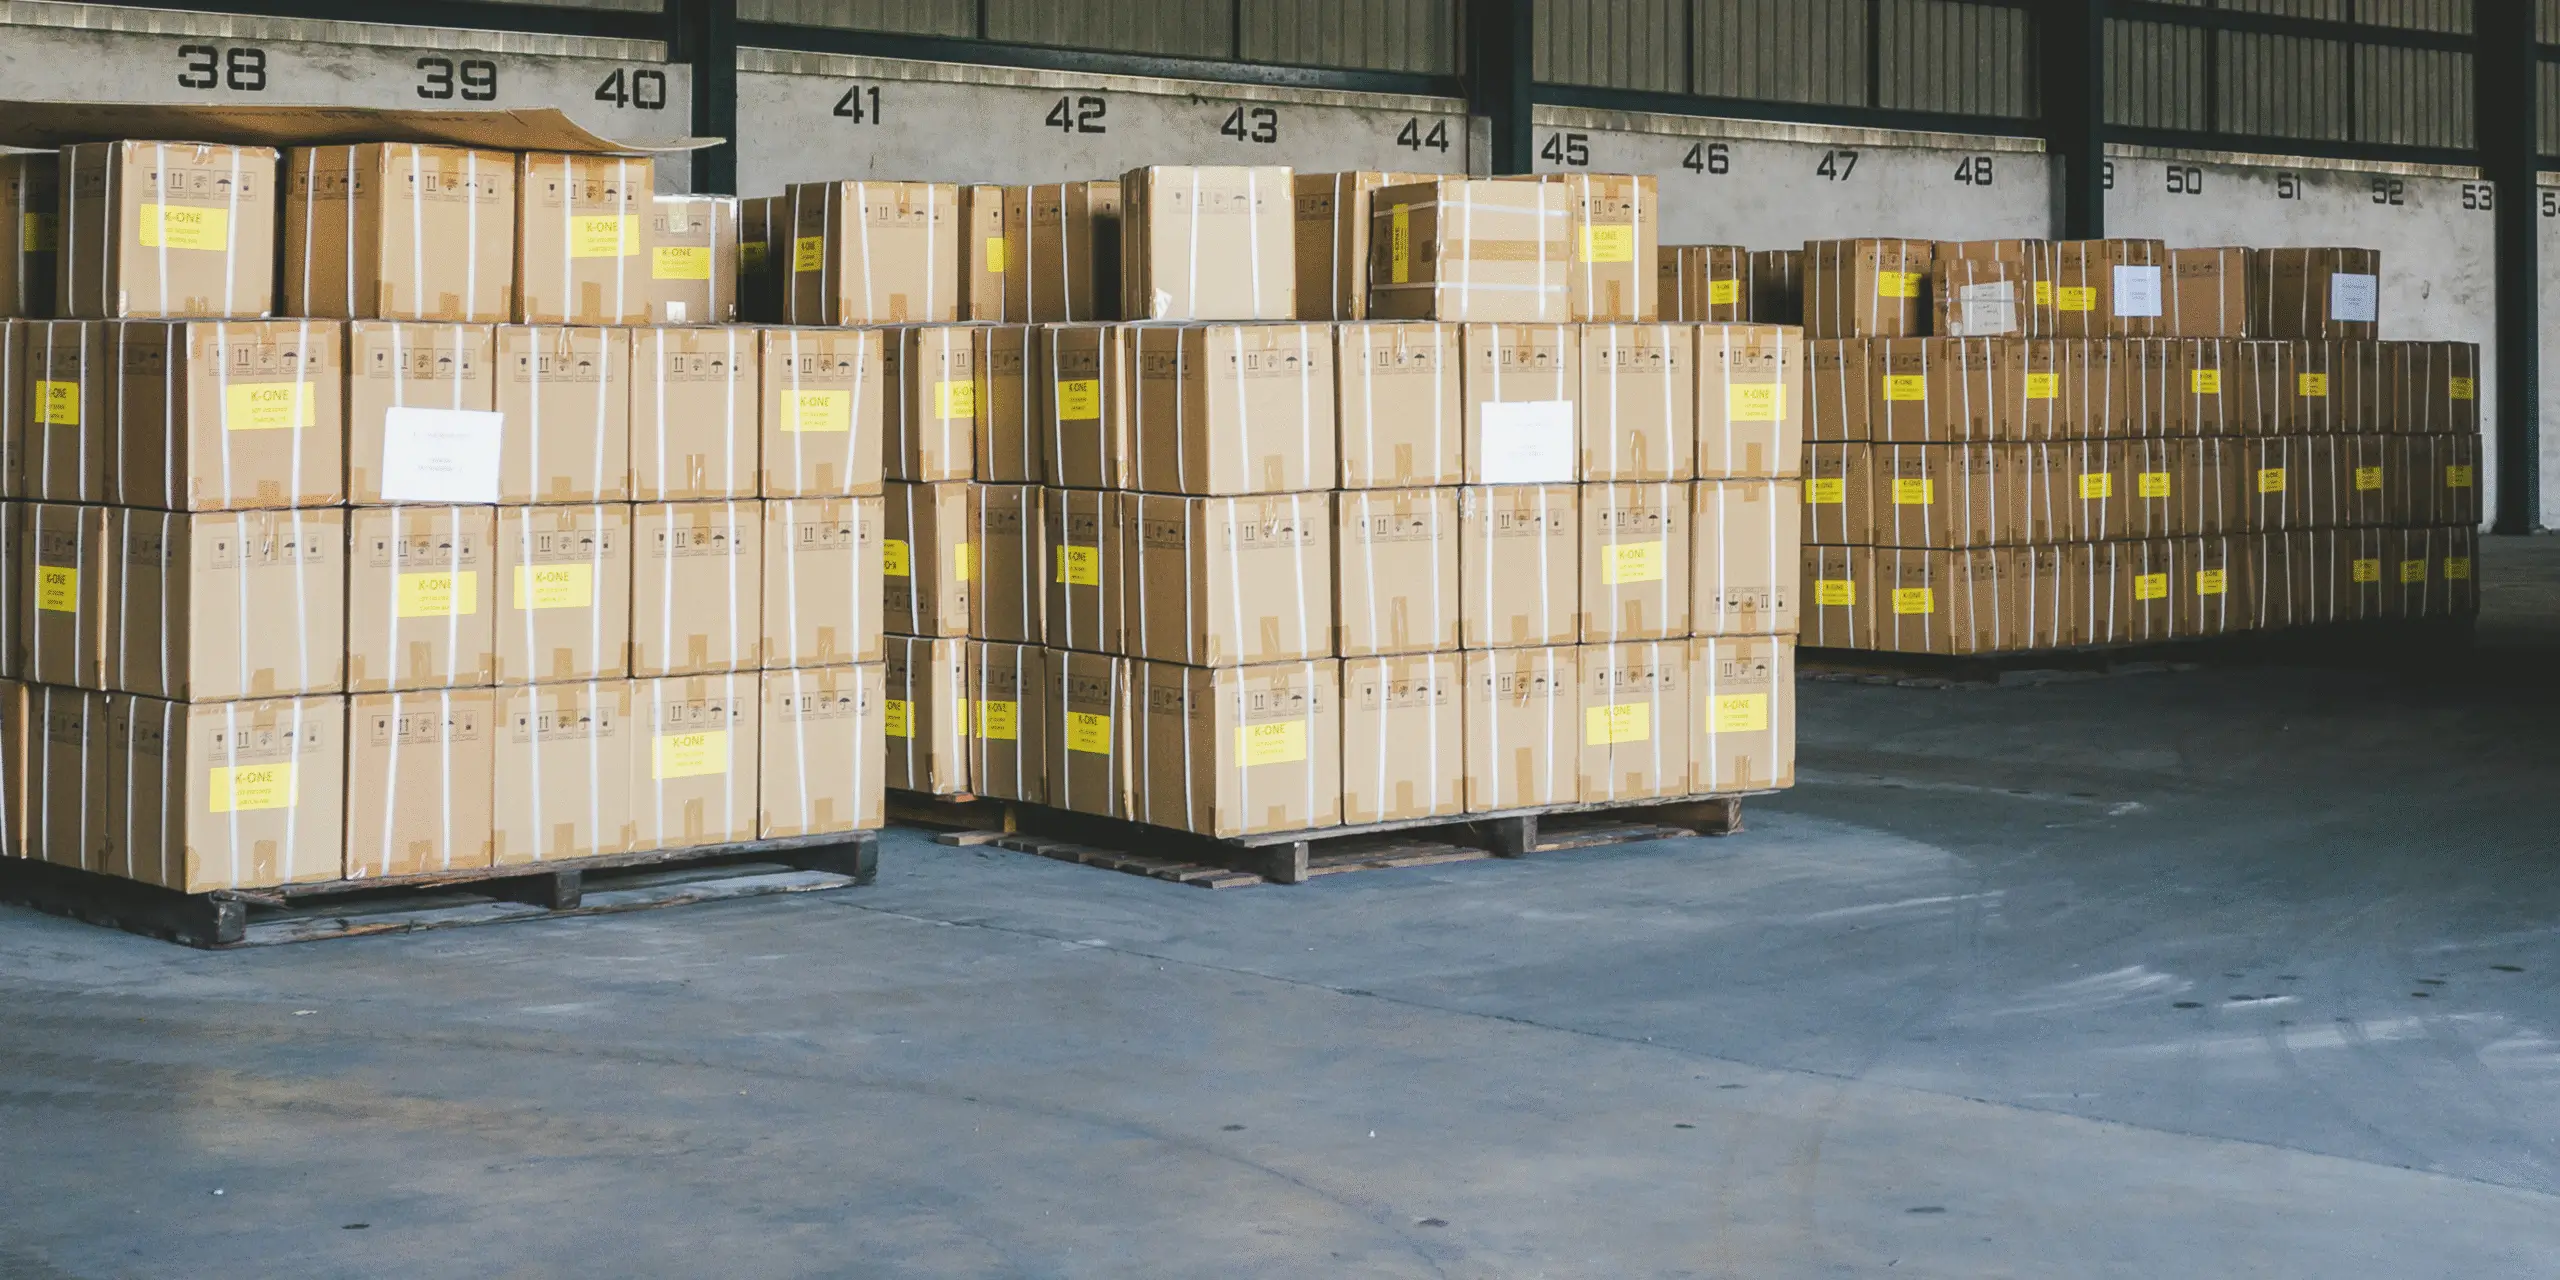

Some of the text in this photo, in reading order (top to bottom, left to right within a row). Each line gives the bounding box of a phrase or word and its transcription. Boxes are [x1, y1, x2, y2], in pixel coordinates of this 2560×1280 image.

[178, 49, 265, 92] 38
[417, 57, 497, 101] 39
[595, 68, 666, 109] 40
[833, 86, 879, 124] 41
[1046, 96, 1106, 133] 42
[1221, 108, 1277, 143] 43
[1397, 116, 1448, 153] 44
[1541, 134, 1588, 166] 45
[1683, 143, 1728, 174] 46
[1817, 150, 1858, 180] 47
[1955, 156, 1992, 185] 48
[2103, 162, 2114, 189] 9
[2167, 166, 2202, 194] 50
[2278, 172, 2301, 200] 51
[2372, 178, 2403, 205] 52
[2462, 184, 2493, 210] 53
[2543, 192, 2560, 217] 5
[165, 211, 202, 225] K-ONE
[585, 221, 618, 232] K-ONE
[662, 247, 692, 257] K-ONE
[50, 387, 67, 399] -ONE
[953, 386, 973, 397] K-ON
[1069, 382, 1087, 392] K-ONE
[1743, 388, 1769, 399] K-ONE
[251, 389, 289, 402] K-ONE
[800, 396, 831, 407] K-ONE
[1619, 548, 1645, 560] K-ONE
[47, 573, 66, 585] K-ONE
[536, 571, 569, 583] K-ONE
[885, 700, 901, 711] -ONE
[1604, 705, 1632, 717] KONE
[1723, 699, 1749, 710] K-ONE
[1078, 714, 1097, 726] K-ONE
[1255, 723, 1286, 736] K-ONE
[673, 735, 705, 748] K-ONE
[236, 771, 273, 784] K-ONE
